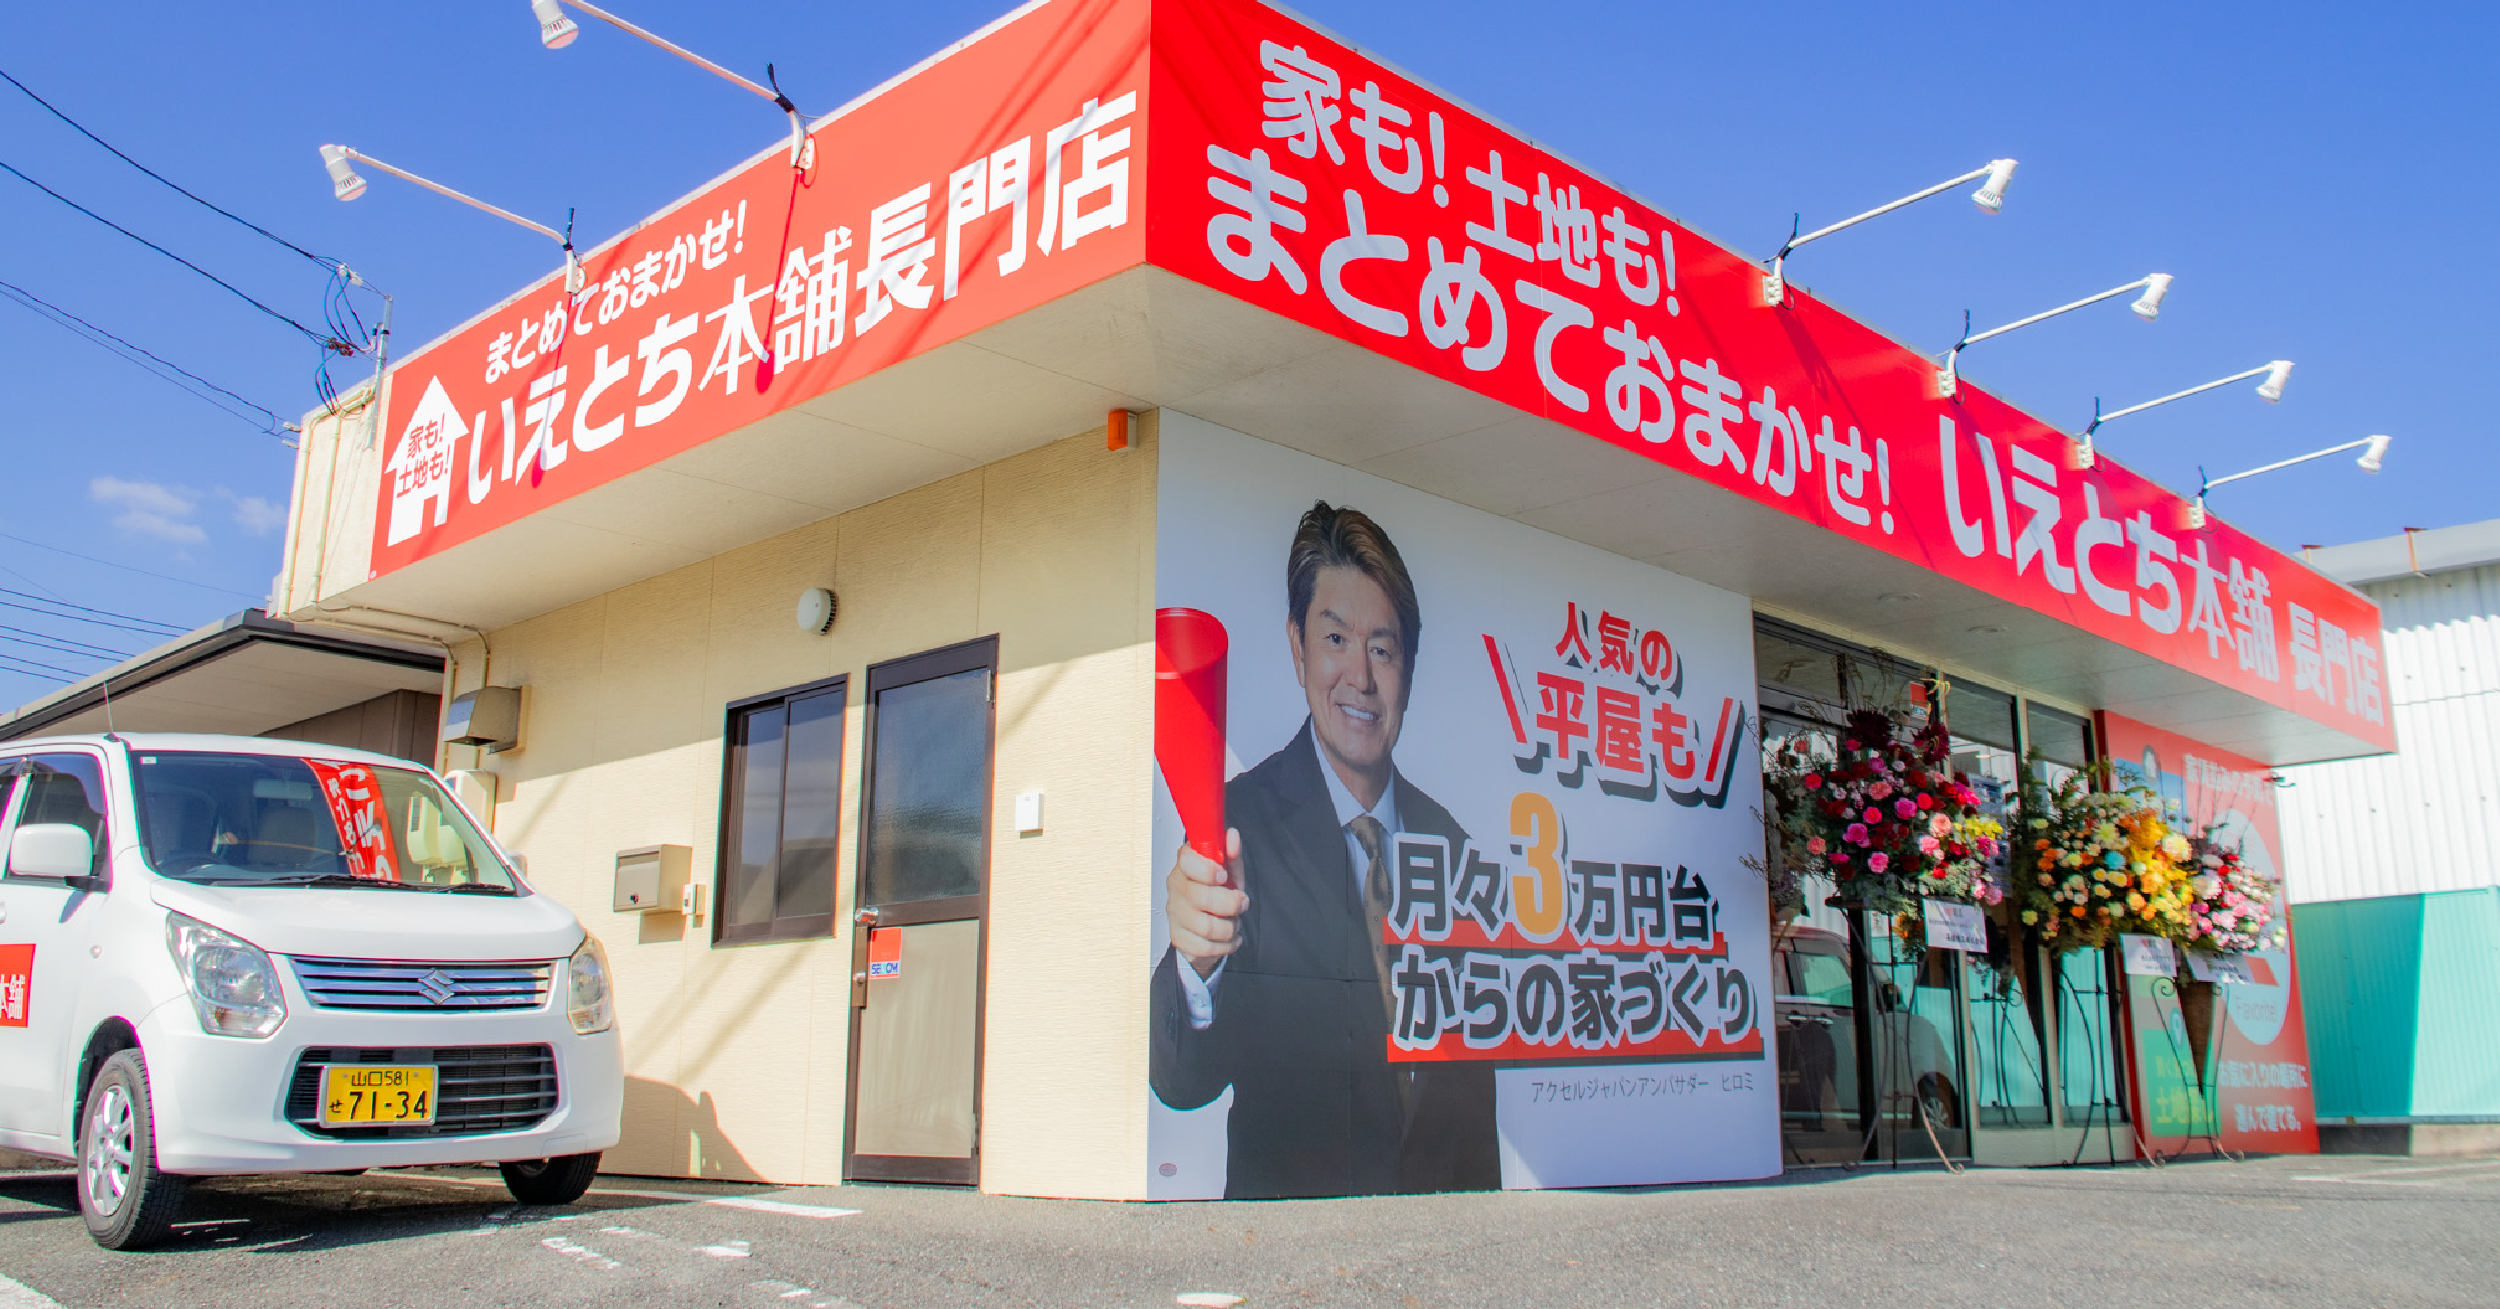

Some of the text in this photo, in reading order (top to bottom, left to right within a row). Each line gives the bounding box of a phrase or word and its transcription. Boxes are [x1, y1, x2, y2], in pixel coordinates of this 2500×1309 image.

[1260, 39, 1680, 316] 家も! 土地も!
[469, 90, 1138, 505] いえとち本舗長門店
[484, 199, 748, 386] まとめておまかせ!
[1206, 143, 1895, 536] まとめておまかせ!
[396, 443, 451, 499] 土地も!
[407, 412, 446, 459] 家も!
[1555, 602, 1677, 686] 人気の
[1536, 671, 1698, 781] 平屋も
[1393, 793, 1719, 946] 月々3万円台
[1396, 952, 1754, 1046] からの家づくり
[330, 1090, 428, 1120] せ 71-34
[1532, 1072, 1754, 1103] アクセルジャパンアンバサダー ヒロミ
